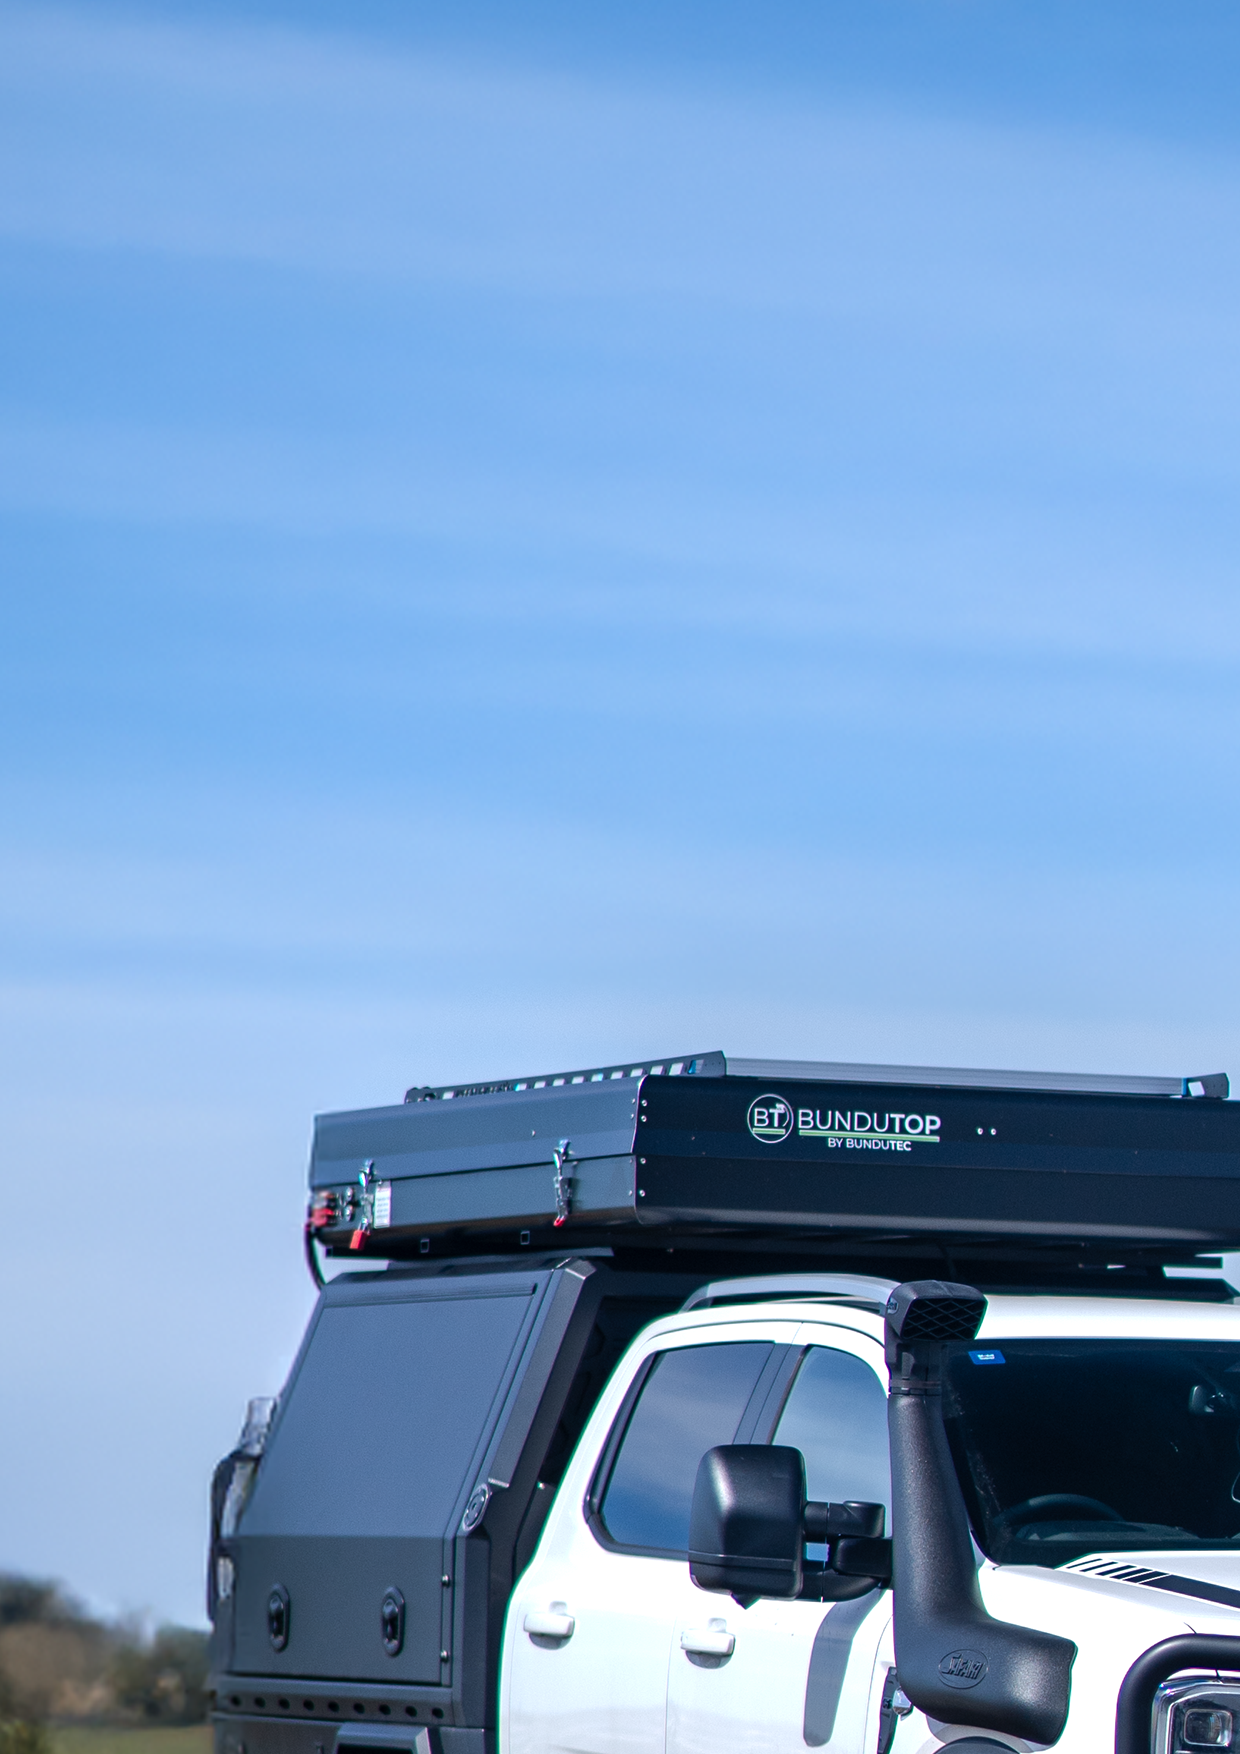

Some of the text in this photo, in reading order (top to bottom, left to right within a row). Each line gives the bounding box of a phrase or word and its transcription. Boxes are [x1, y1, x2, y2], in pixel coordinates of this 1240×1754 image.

[798, 1109, 941, 1135] BUNDUTOP
[828, 1138, 912, 1151] BY BUNDUTEC
[941, 1653, 985, 1680] SAFARI
